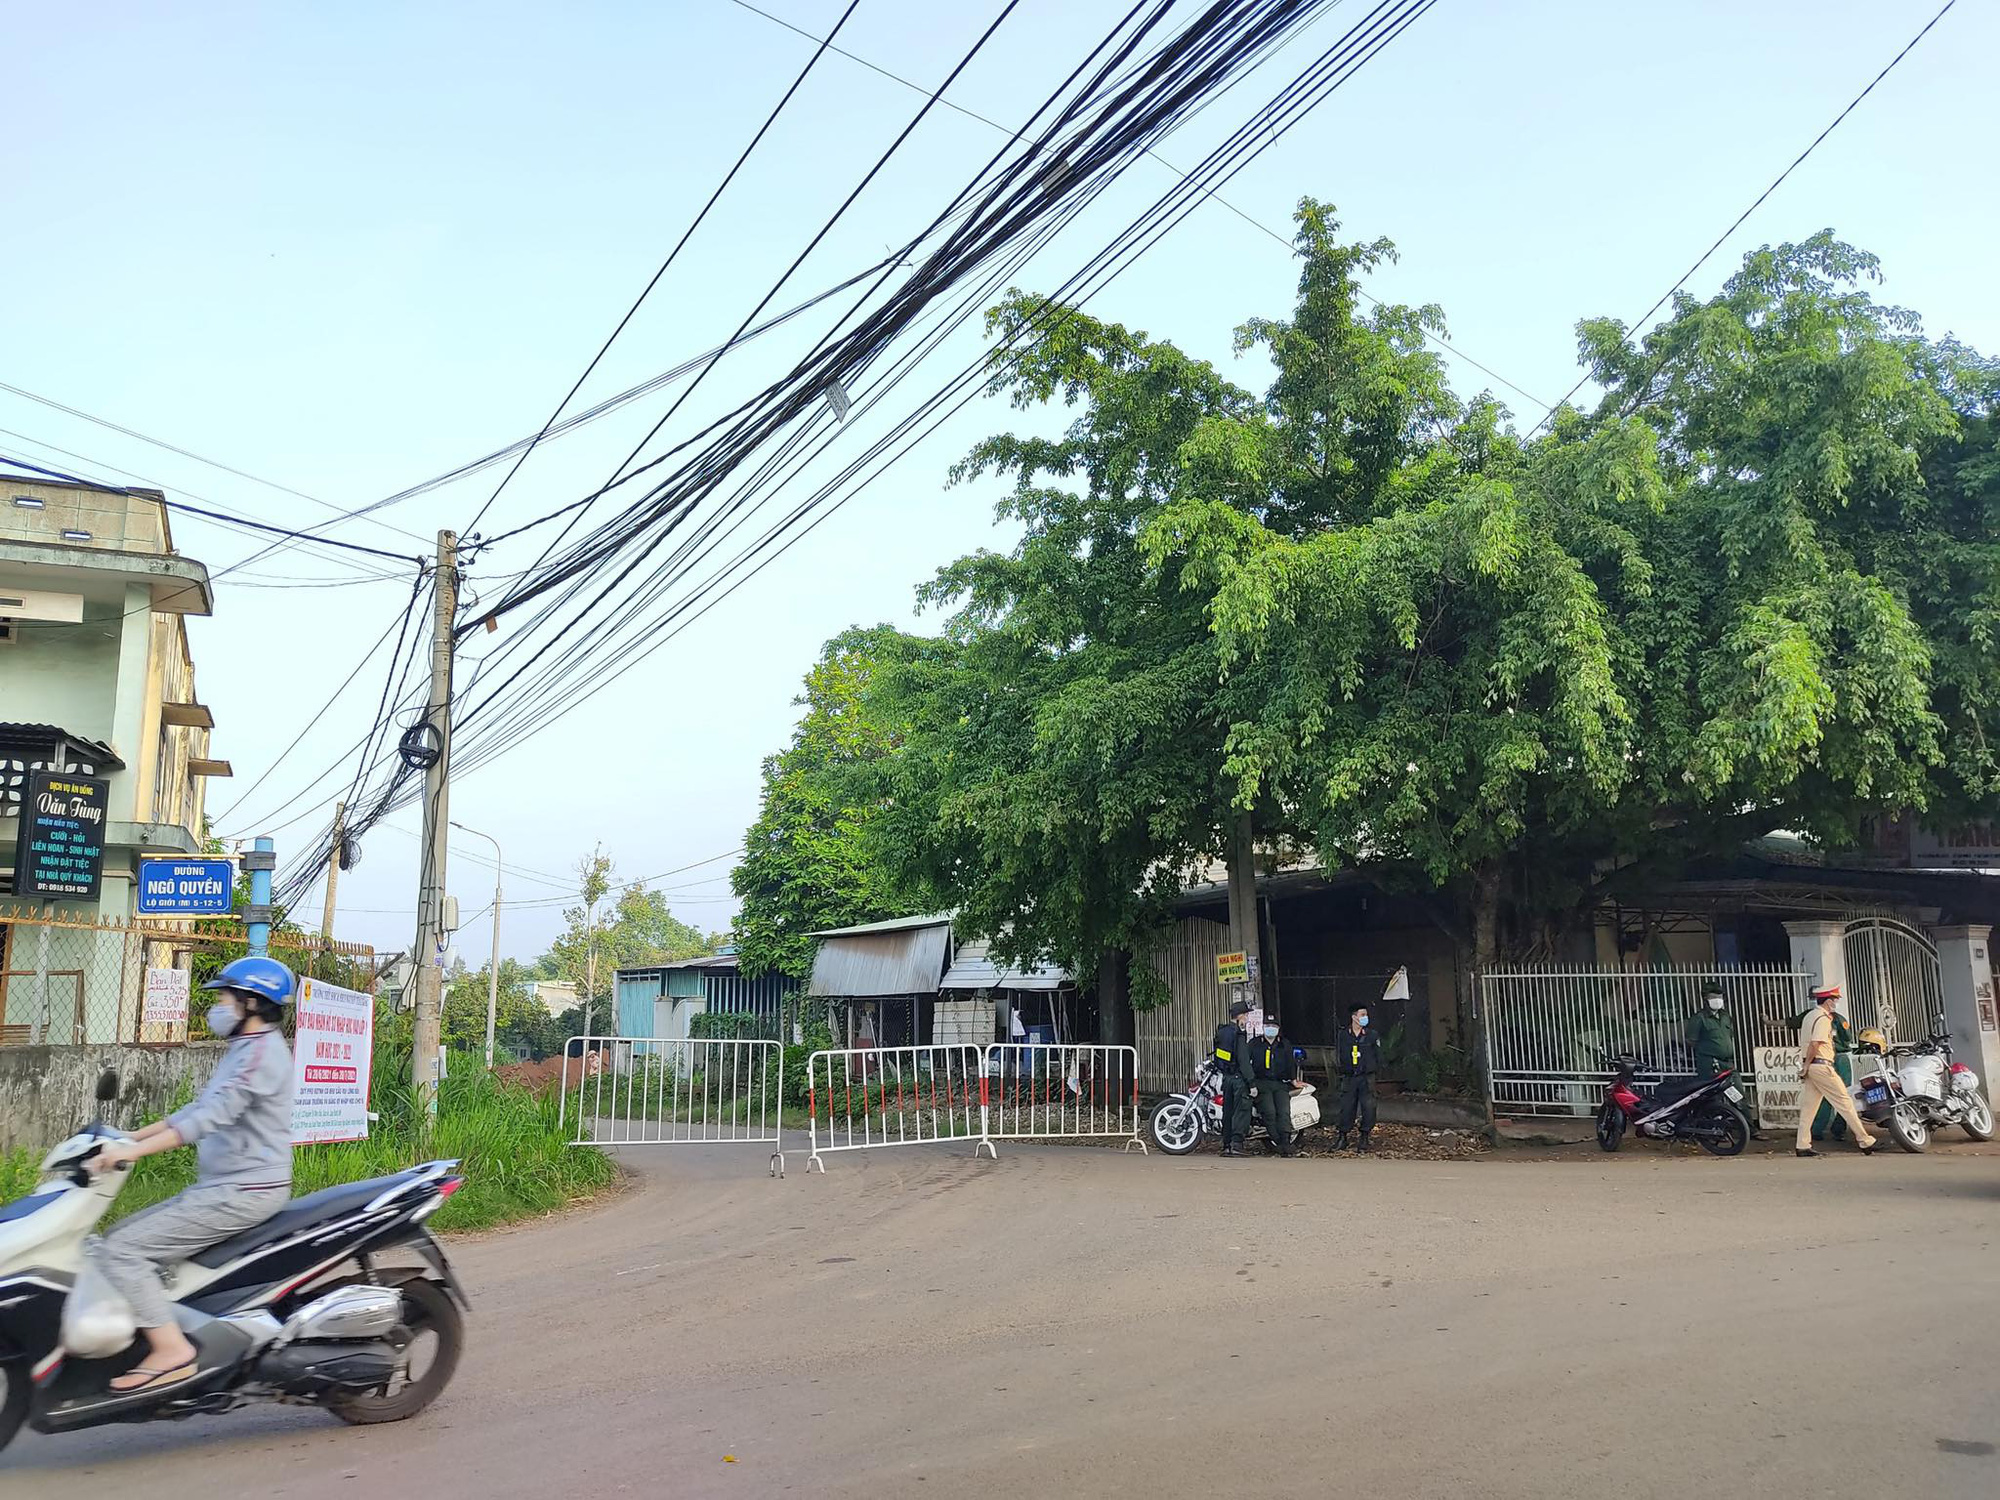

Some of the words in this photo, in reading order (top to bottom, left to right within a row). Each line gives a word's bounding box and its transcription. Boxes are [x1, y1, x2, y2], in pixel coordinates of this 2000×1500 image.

[37, 792, 67, 815] Văn
[70, 797, 102, 825] Tùng
[32, 840, 46, 851] LIÊN
[48, 843, 65, 852] HOAN
[69, 846, 83, 855] SINH
[40, 855, 59, 867] NHẬN
[74, 858, 90, 870] TIỆC
[174, 864, 205, 876] ĐƯỜNG
[35, 869, 46, 880] TẠI
[46, 869, 59, 880] NHÀ
[60, 870, 72, 882] QUÝ
[73, 871, 93, 883] KHÁCH
[148, 878, 175, 894] NGÔ
[180, 876, 222, 896] QUYỀN
